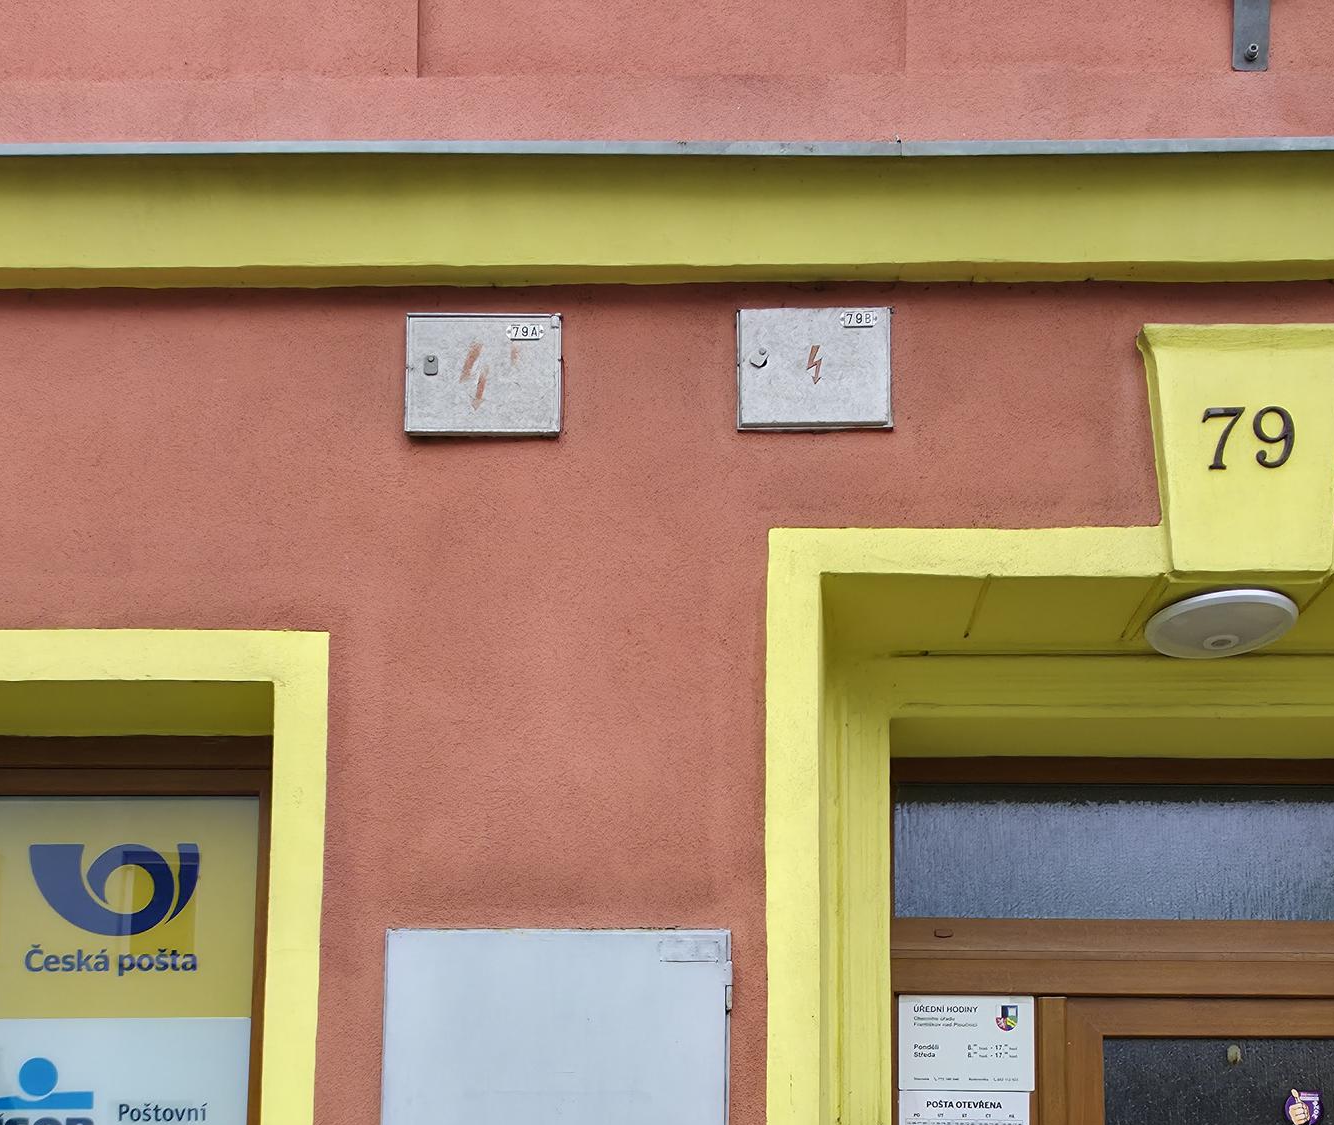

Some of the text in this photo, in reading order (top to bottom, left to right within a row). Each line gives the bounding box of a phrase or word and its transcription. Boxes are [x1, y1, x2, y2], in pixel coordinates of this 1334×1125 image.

[845, 312, 872, 326] 79B
[511, 325, 538, 338] 79A
[1201, 406, 1295, 470] 79
[24, 944, 198, 976] Česká pošta
[913, 1004, 978, 1013] ÚŘEDNÍ HODINY
[927, 1099, 1002, 1109] POŠTA OTEVŘENA
[117, 1102, 207, 1123] Poštovní
